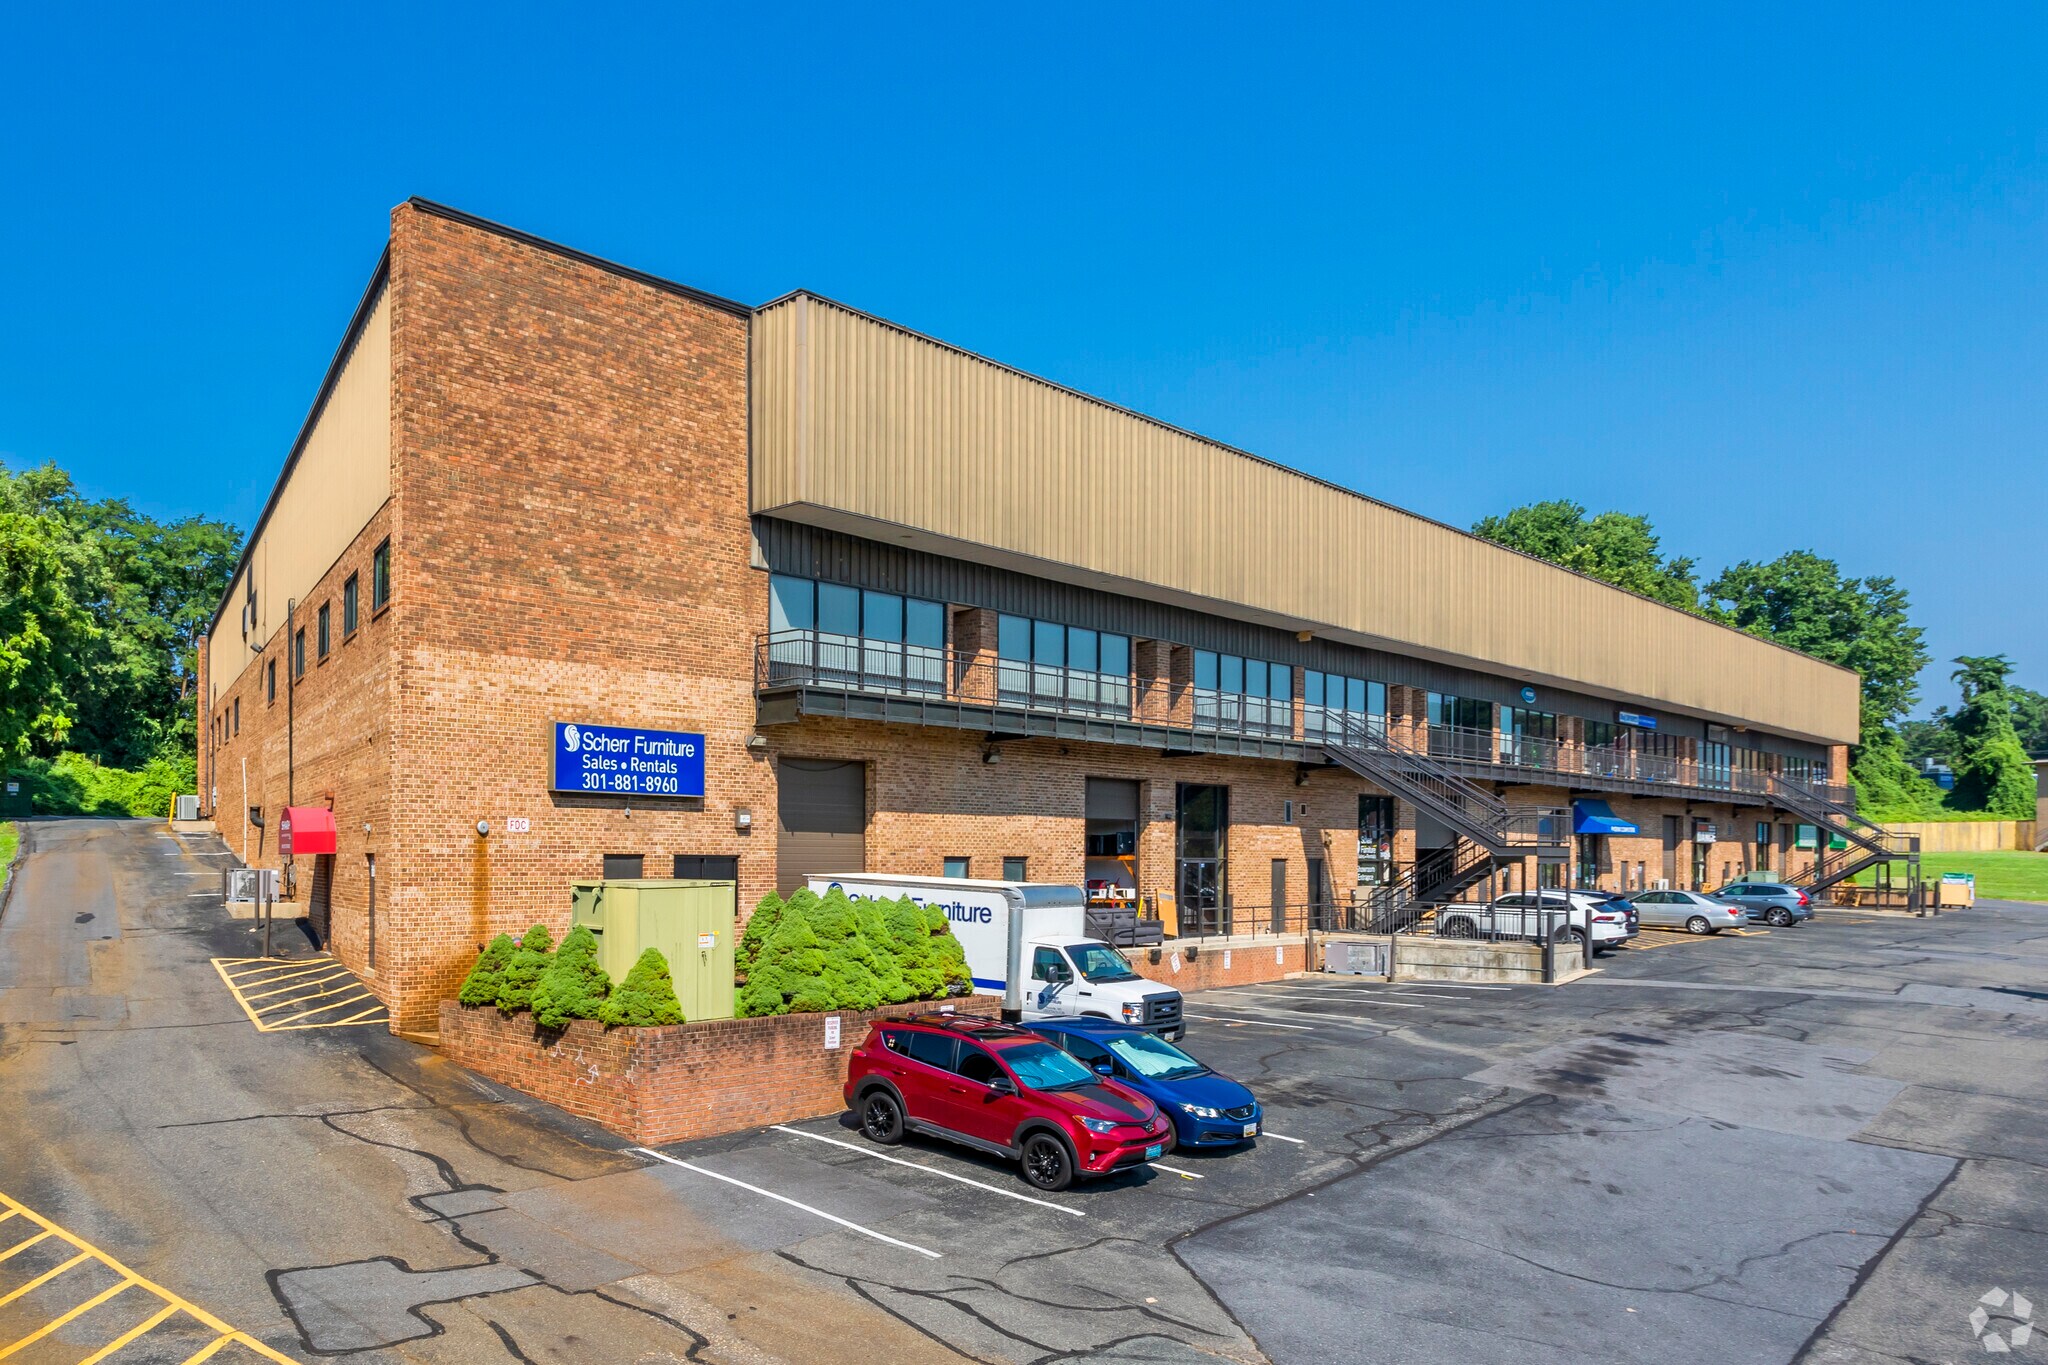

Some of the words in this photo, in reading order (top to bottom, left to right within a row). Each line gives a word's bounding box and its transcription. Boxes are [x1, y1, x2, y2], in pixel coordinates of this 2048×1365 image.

[582, 731, 630, 753] Scherr
[634, 735, 695, 758] Furniture
[582, 753, 618, 771] Sales
[630, 756, 678, 774] Rentals
[582, 772, 678, 793] 301-881-8960
[509, 820, 527, 830] FDC
